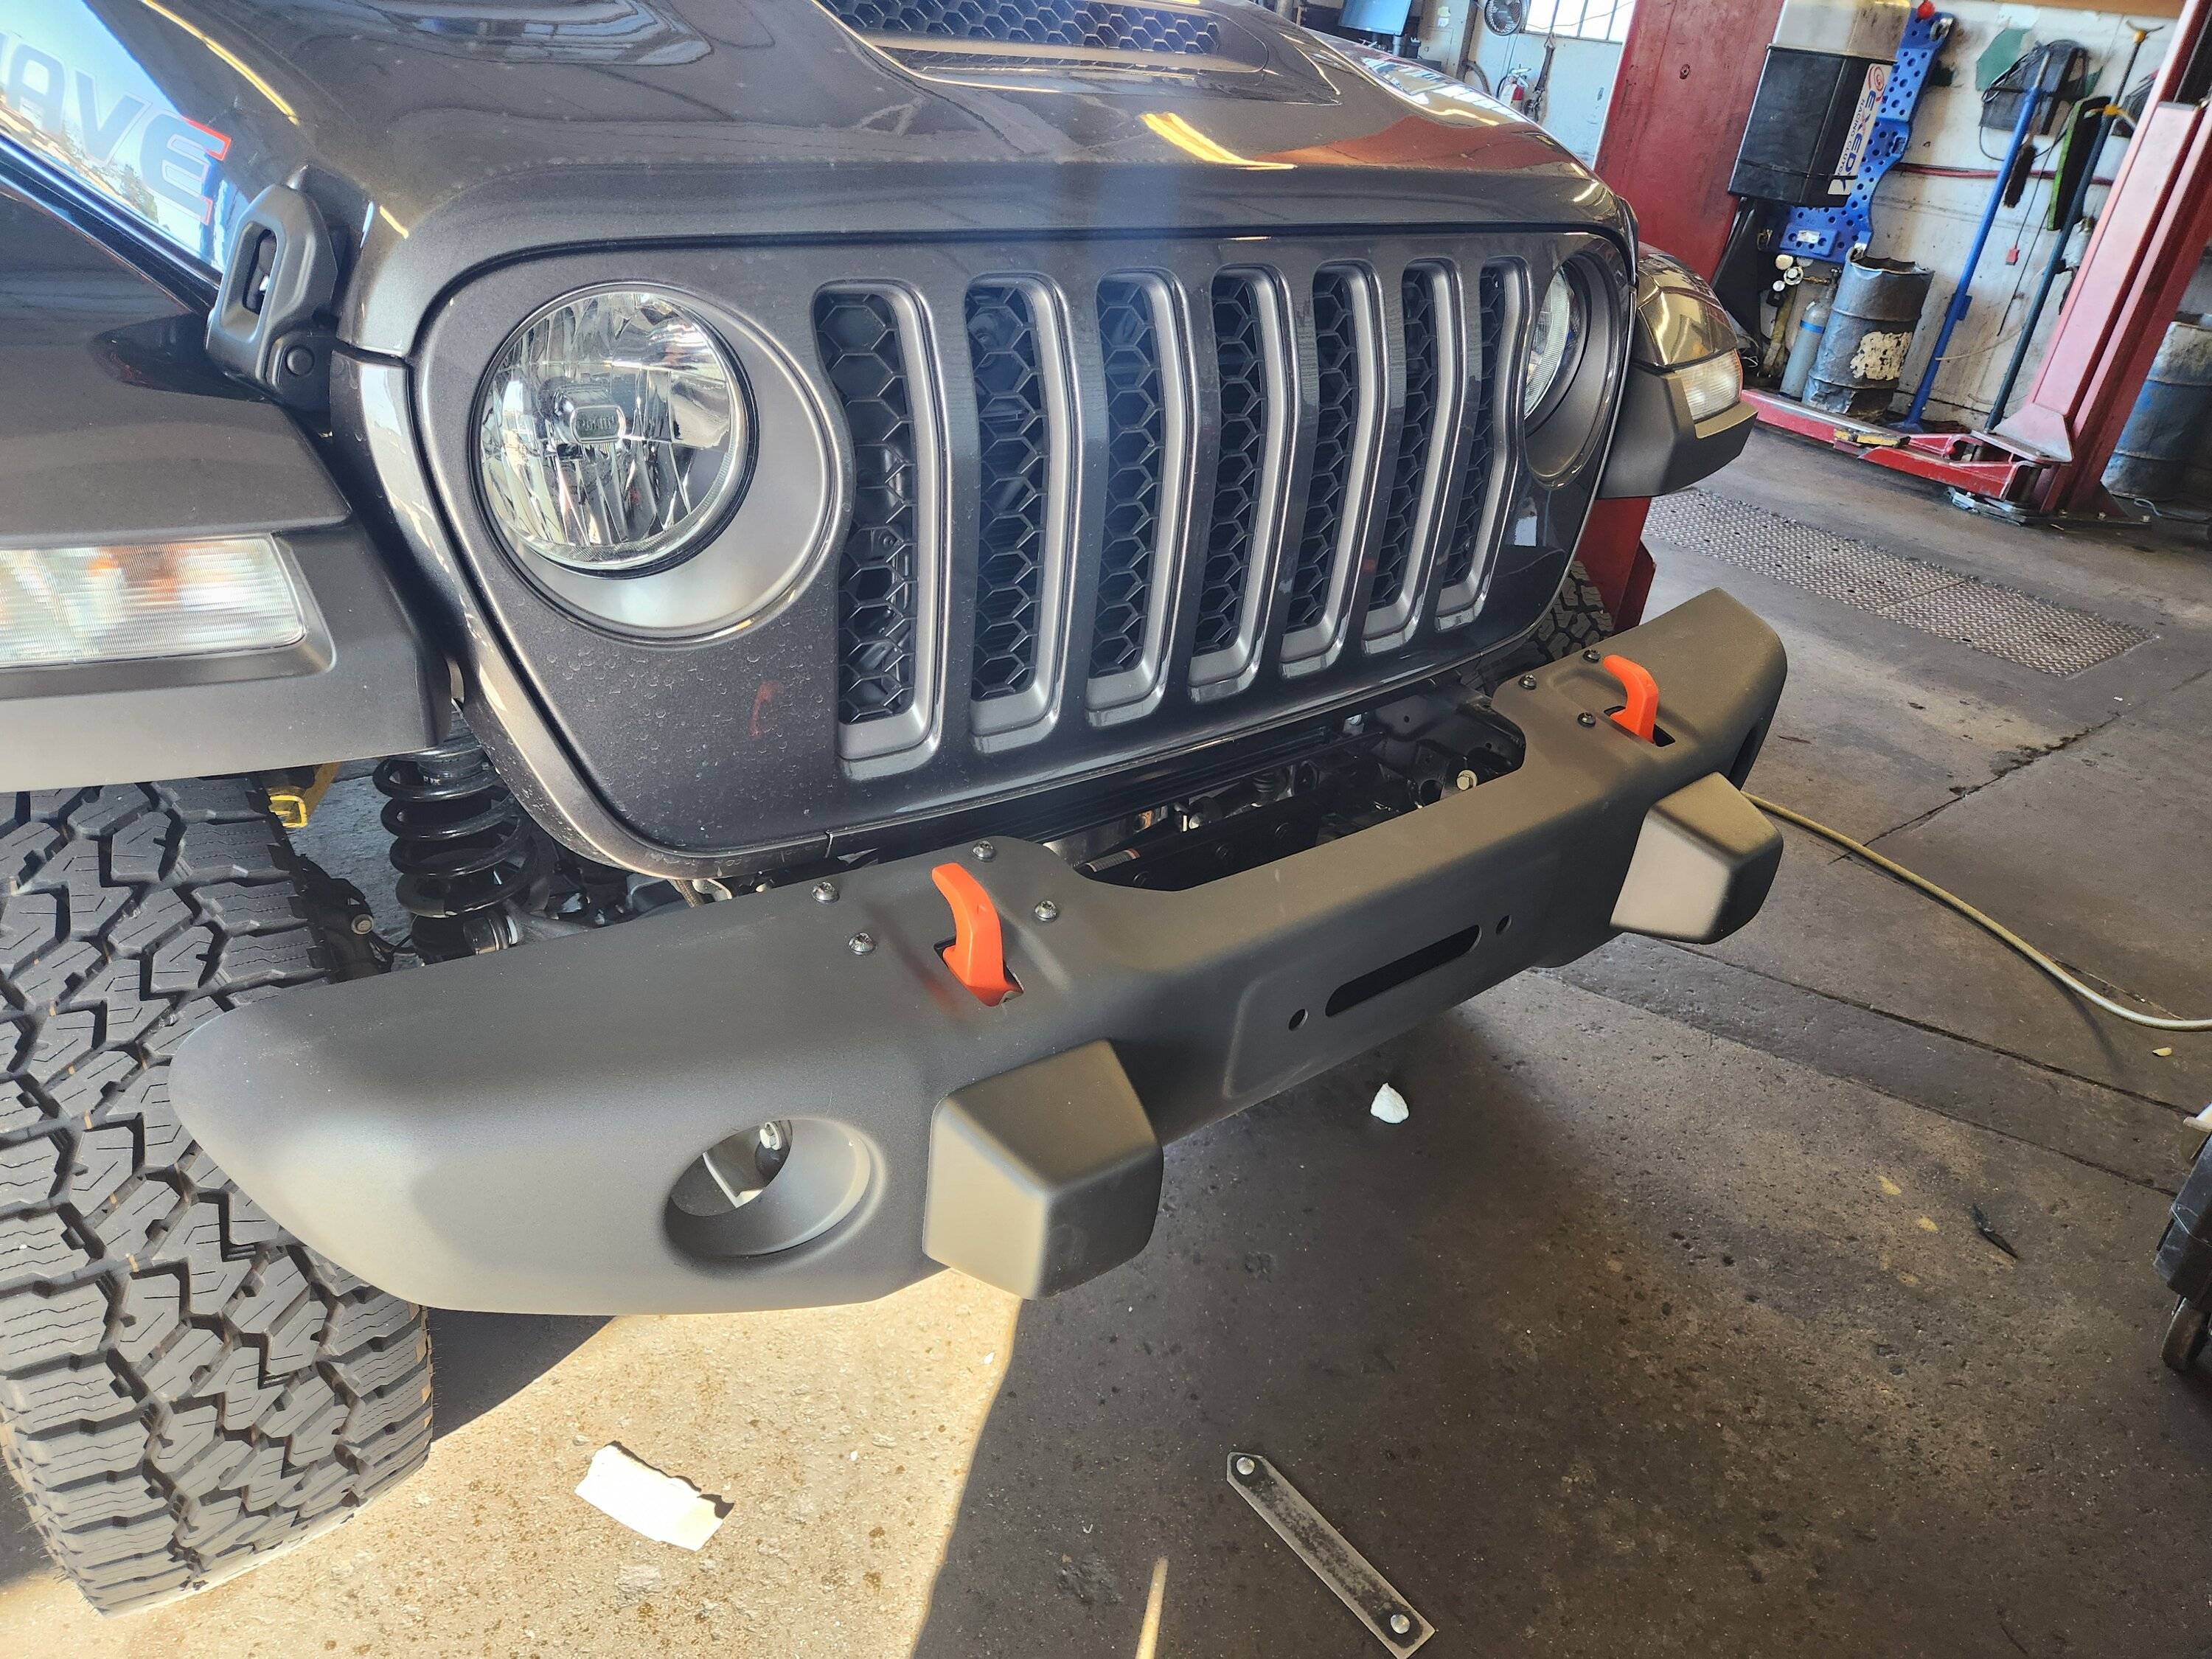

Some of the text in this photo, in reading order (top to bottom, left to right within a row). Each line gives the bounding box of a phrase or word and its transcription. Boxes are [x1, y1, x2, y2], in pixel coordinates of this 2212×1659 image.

[0, 33, 232, 225] AVE
[1837, 99, 1865, 175] RACING CLUTC
[1841, 90, 1877, 192] EXEDY
